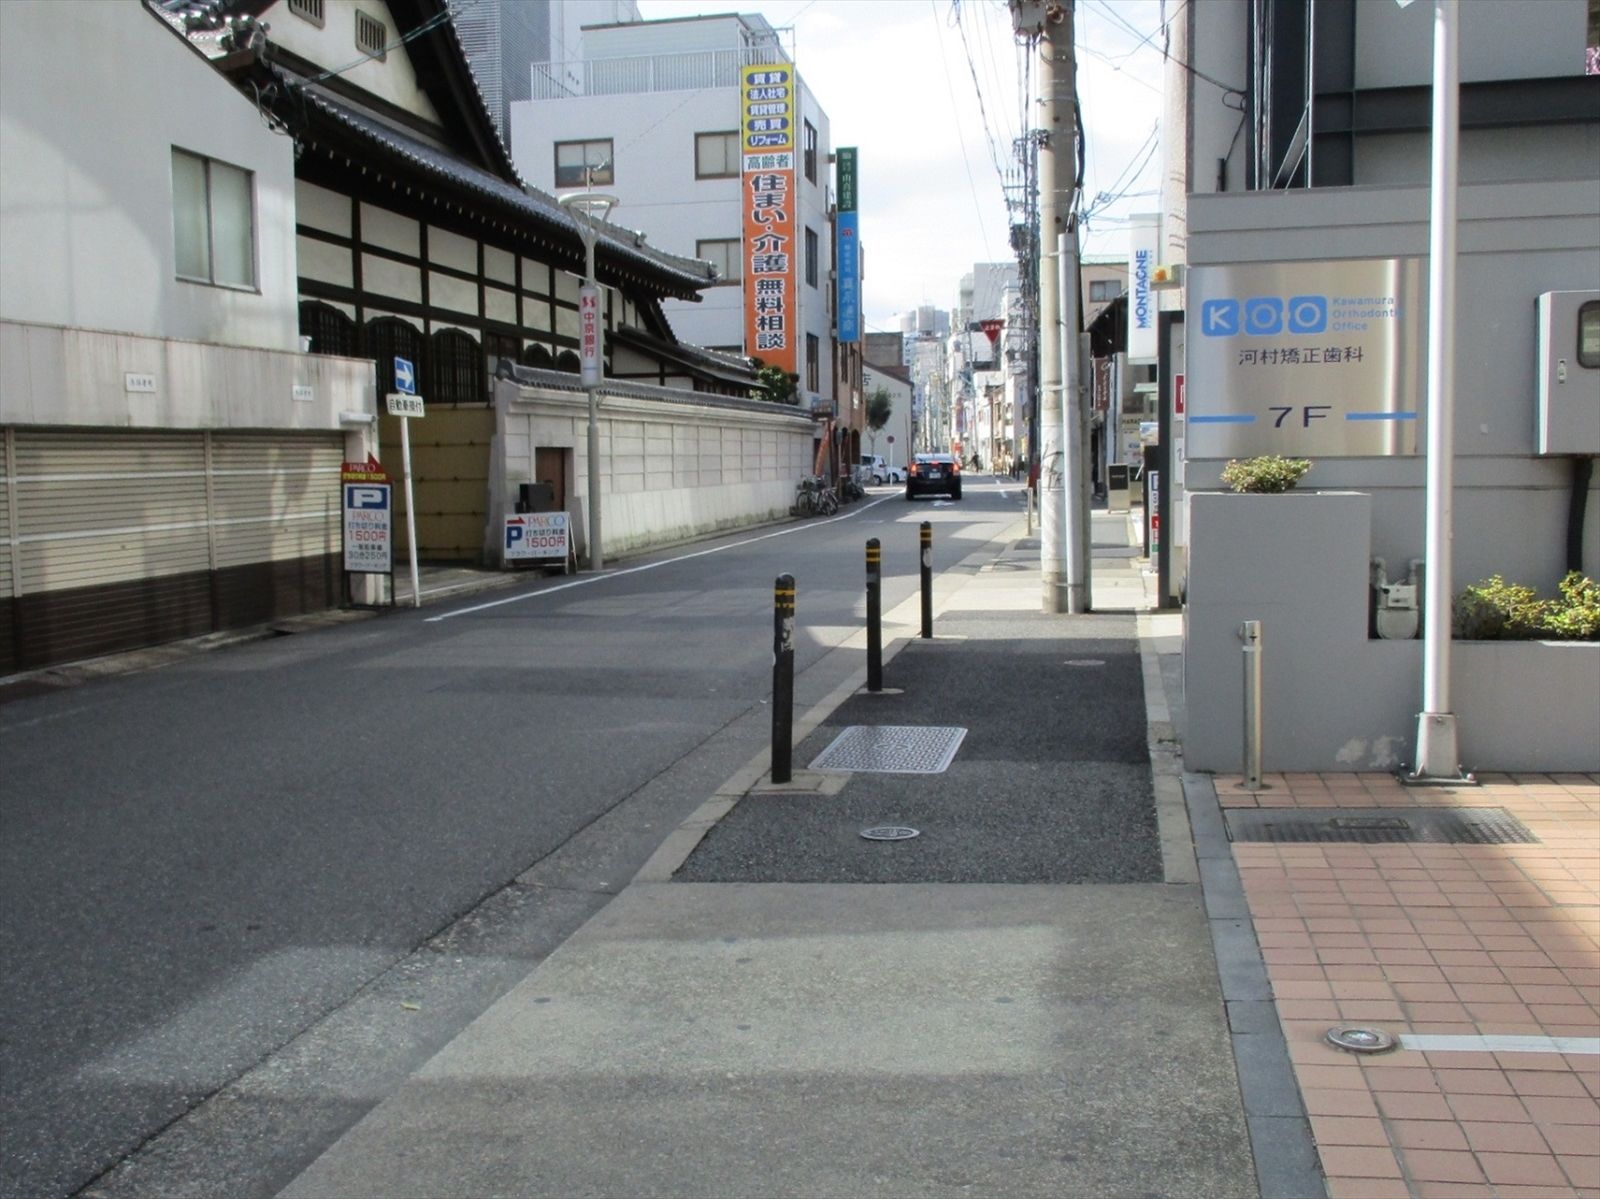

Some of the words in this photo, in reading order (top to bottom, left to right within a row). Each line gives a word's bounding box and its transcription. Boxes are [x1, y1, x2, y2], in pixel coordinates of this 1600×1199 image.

[750, 134, 787, 146] リフォーム
[747, 154, 789, 170] 高齢者
[1135, 249, 1148, 329] MONTAGNE
[1333, 296, 1395, 306] Kawamura
[755, 279, 786, 351] 無料相談
[1333, 307, 1404, 319] Orthodont
[1333, 321, 1369, 331] Office
[1239, 346, 1364, 366] 河村矯正歯科
[1268, 405, 1333, 429] 7F
[353, 488, 384, 508] P
[351, 511, 385, 521] PARCO
[527, 514, 566, 527] PARCO
[506, 526, 523, 549] P
[525, 536, 566, 548] 1500円
